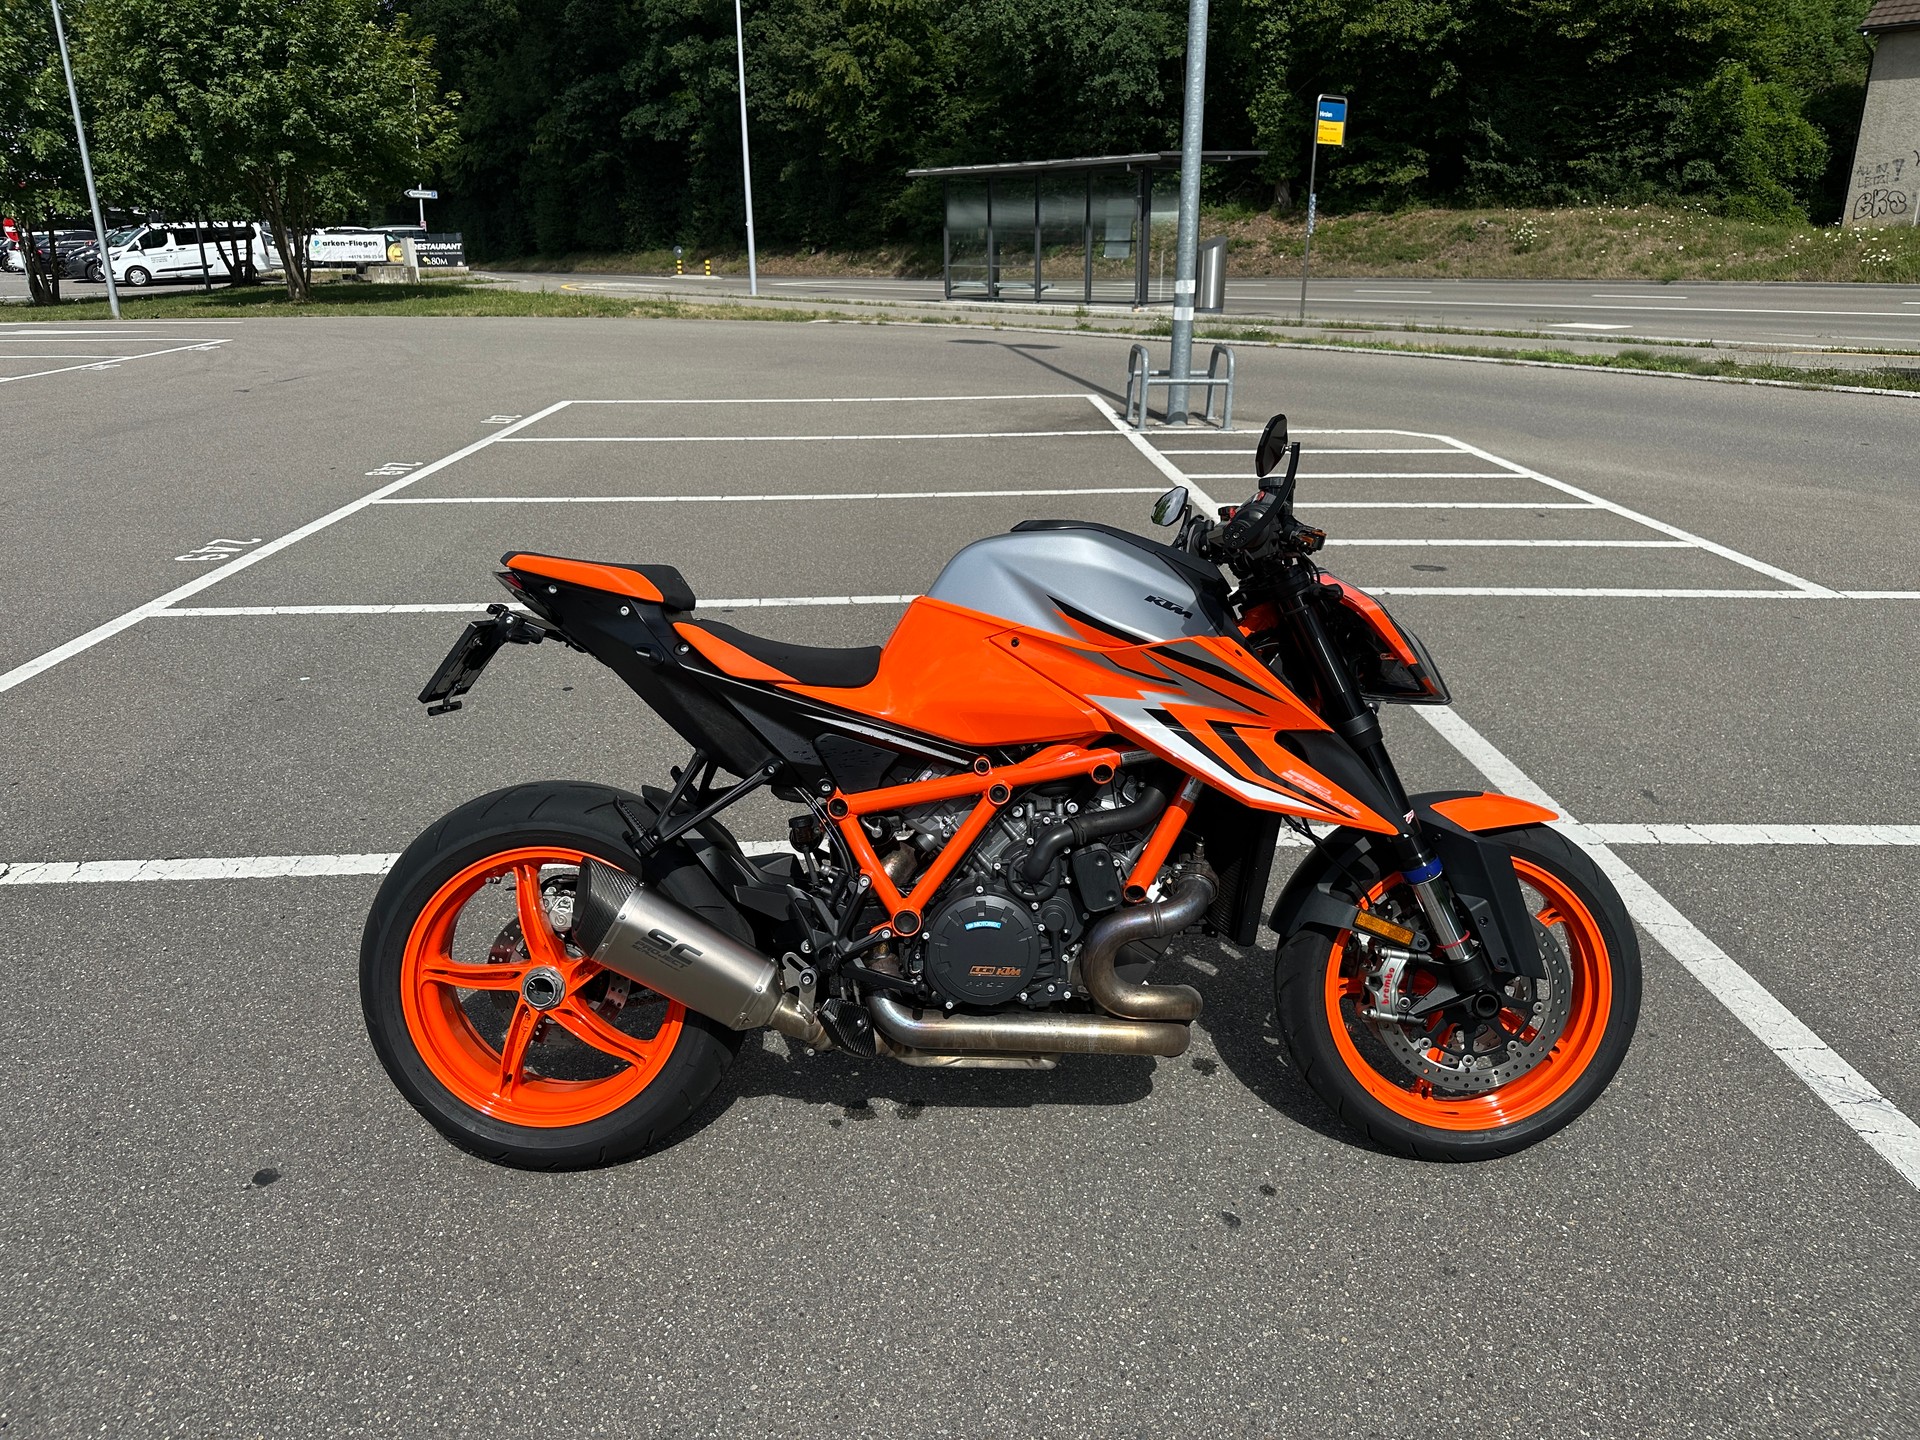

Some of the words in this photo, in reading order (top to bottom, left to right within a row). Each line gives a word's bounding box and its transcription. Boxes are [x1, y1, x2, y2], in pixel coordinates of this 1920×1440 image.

[431, 256, 448, 266] 80M
[174, 537, 262, 562] 249
[1144, 594, 1194, 620] KTM
[634, 940, 689, 969] PROJECT
[640, 928, 704, 966] SC
[996, 966, 1021, 976] KTM
[1381, 967, 1395, 1005] brembo
